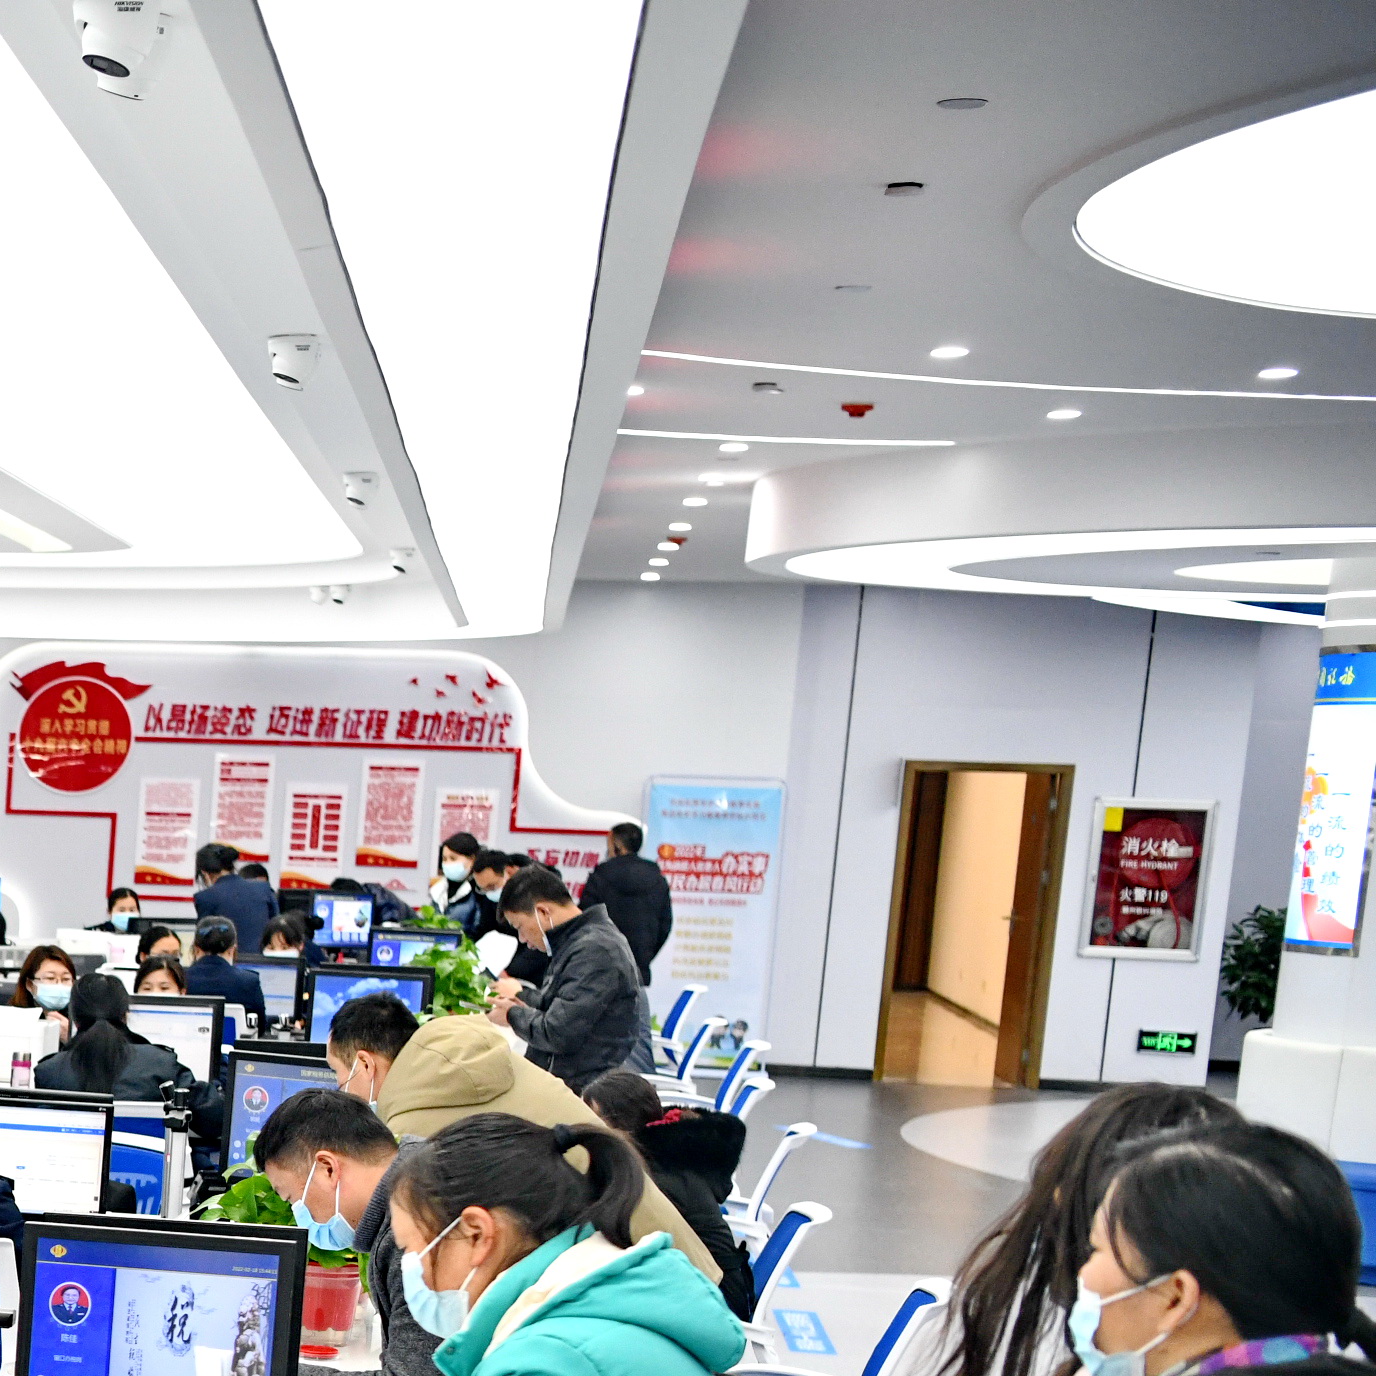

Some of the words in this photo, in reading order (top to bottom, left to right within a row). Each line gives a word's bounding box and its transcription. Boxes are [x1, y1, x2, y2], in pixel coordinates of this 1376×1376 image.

[144, 703, 257, 737] 以昂扬姿态
[266, 706, 389, 740] 迈进新征程
[396, 709, 512, 744] 建功新时代
[1121, 836, 1179, 858] 消火栓
[1120, 859, 1138, 869] FIRE
[1141, 860, 1179, 870] HYDRANT
